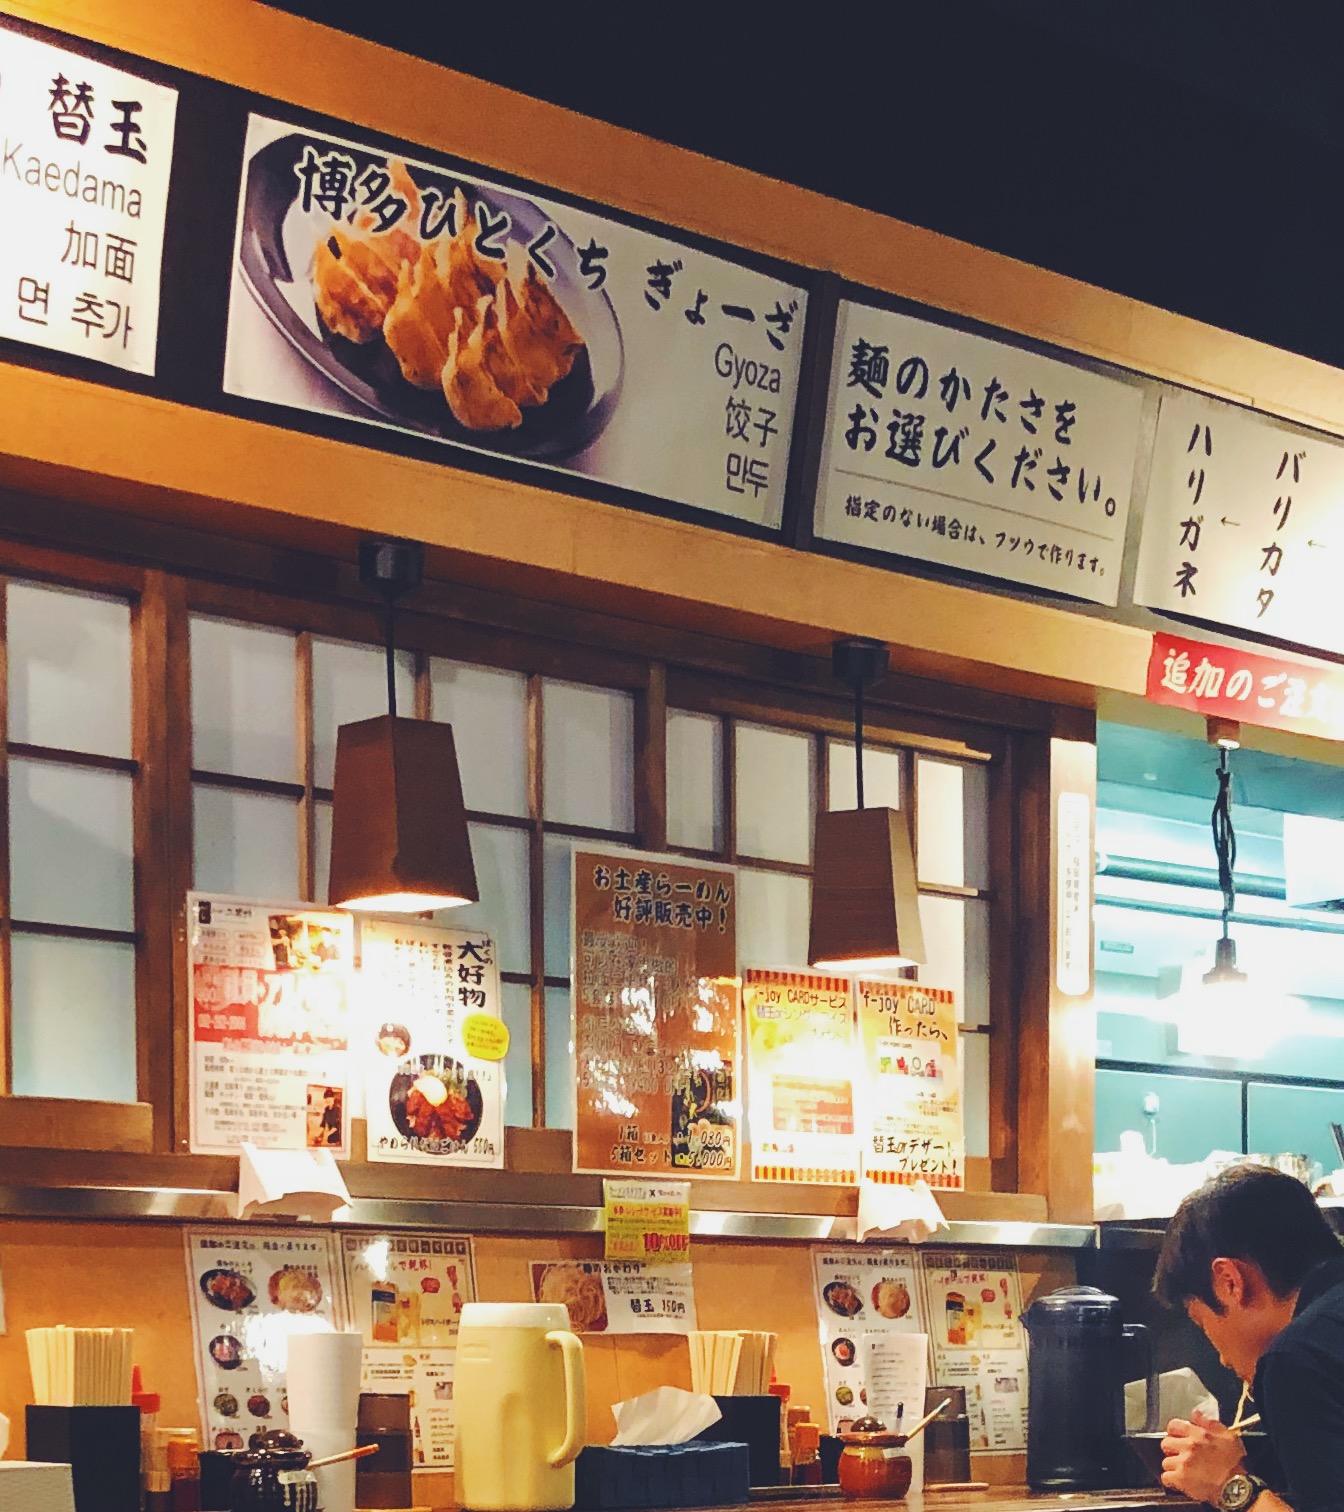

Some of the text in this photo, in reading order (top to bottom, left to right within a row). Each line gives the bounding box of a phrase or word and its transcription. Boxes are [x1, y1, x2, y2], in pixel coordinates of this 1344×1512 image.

[48, 72, 148, 165] 替玉
[2, 137, 143, 220] Kaedama
[60, 219, 138, 285] 加面
[18, 276, 135, 350] 면 추가
[714, 342, 782, 394] Gyoza
[845, 337, 1078, 445] 麺のかたさを
[724, 398, 779, 448] 饺子
[726, 452, 769, 496] 만두
[844, 402, 1116, 518] お選びください。
[1173, 423, 1213, 598] ハリガネ
[1255, 450, 1307, 620] バリカタ
[594, 866, 730, 904] お土産らーめん
[457, 941, 487, 1008] 大好物
[863, 990, 936, 1016] f-joy CARD
[661, 1299, 686, 1314] 150円
